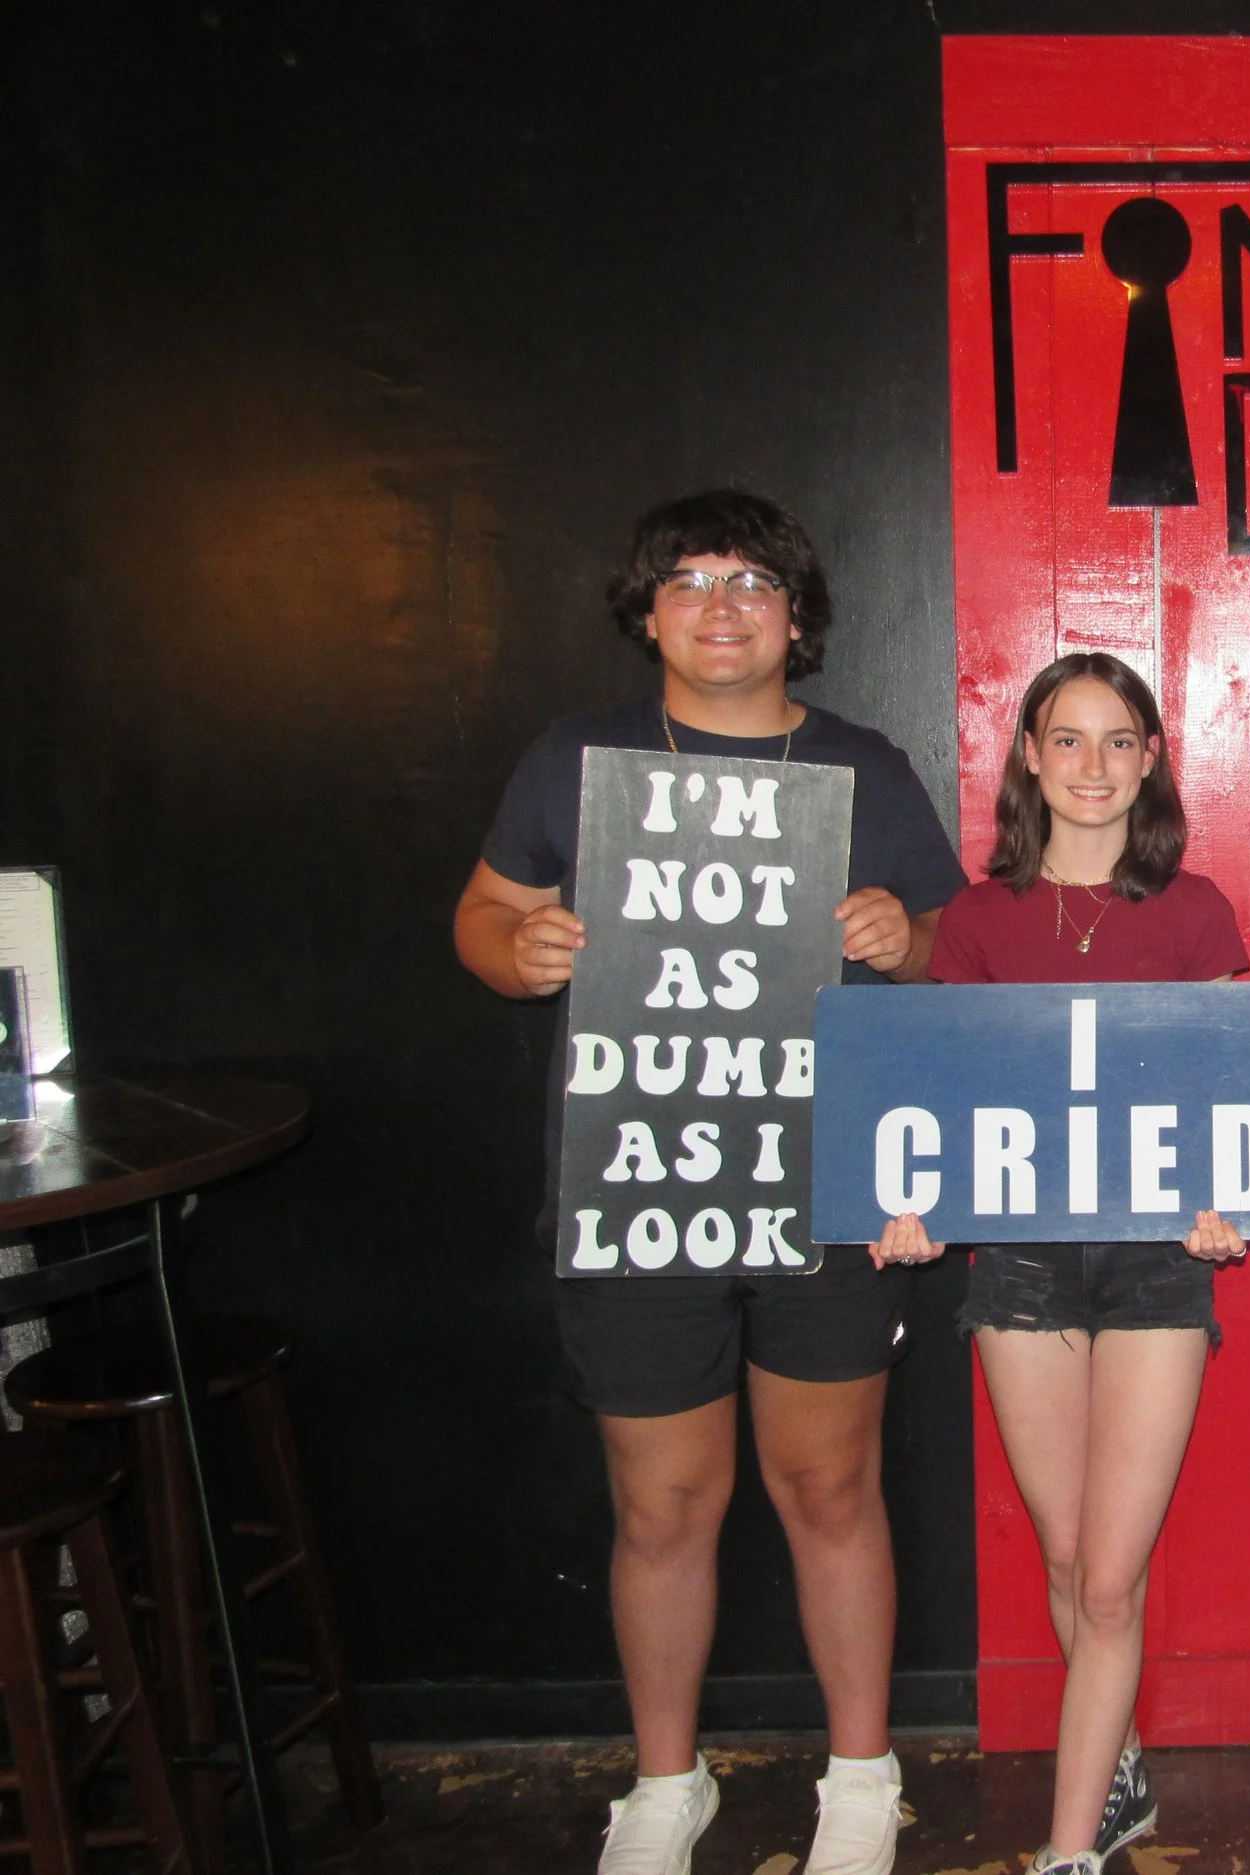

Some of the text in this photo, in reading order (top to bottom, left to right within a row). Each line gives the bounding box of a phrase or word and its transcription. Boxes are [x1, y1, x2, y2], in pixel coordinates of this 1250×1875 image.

[643, 771, 782, 839] I'M
[622, 858, 795, 926] NOT
[645, 948, 759, 1010] AS
[567, 1033, 814, 1097] DUMB
[1071, 999, 1096, 1090] I
[603, 1121, 785, 1182] AS I
[572, 1208, 805, 1270] LOOK
